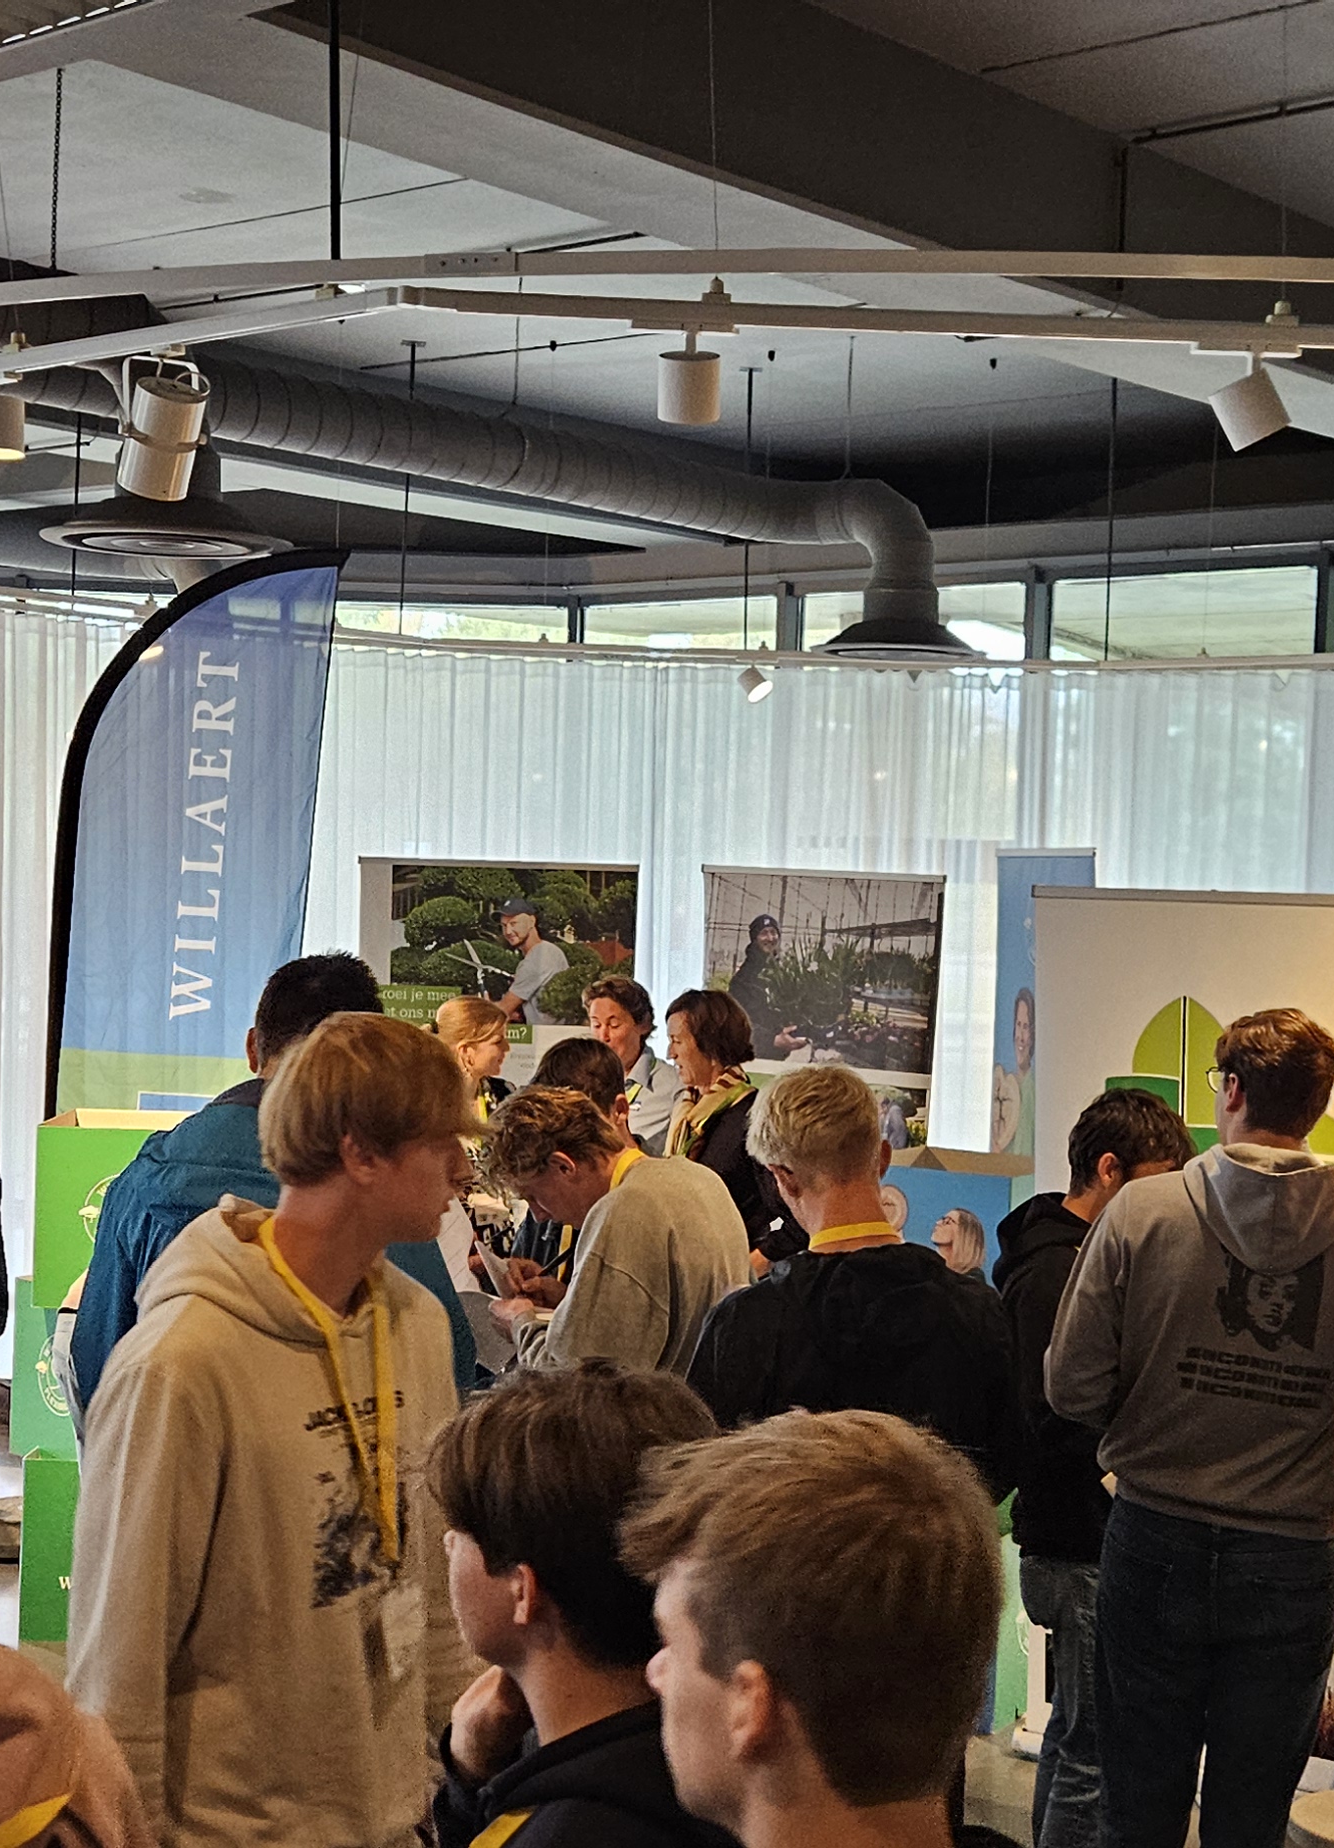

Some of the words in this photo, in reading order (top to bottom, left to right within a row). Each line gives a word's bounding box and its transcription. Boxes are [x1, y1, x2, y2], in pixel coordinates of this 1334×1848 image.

[169, 651, 240, 1021] WILLAERT
[382, 988, 407, 1000] roei
[411, 989, 423, 1002] je
[399, 1008, 424, 1019] ons
